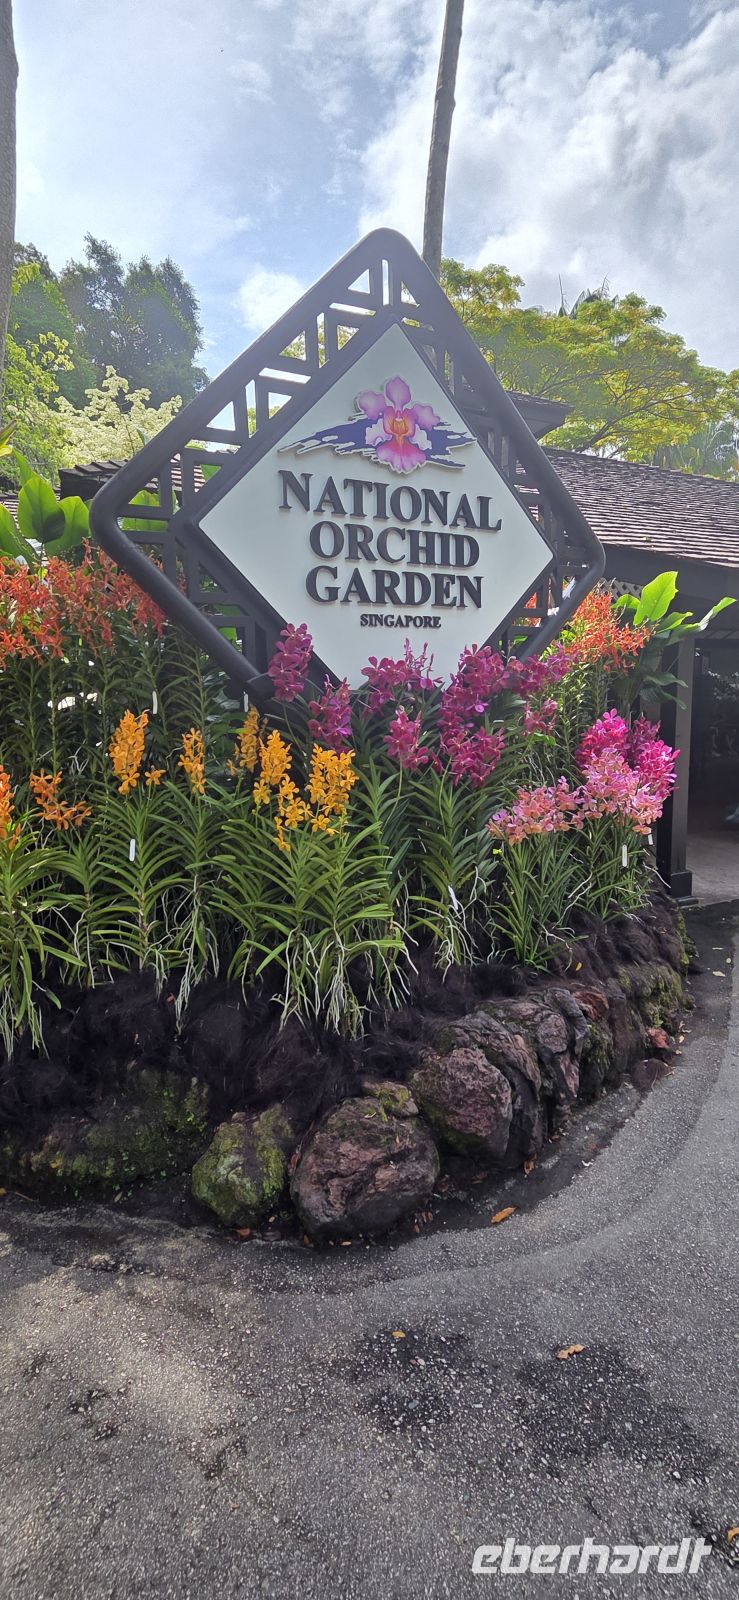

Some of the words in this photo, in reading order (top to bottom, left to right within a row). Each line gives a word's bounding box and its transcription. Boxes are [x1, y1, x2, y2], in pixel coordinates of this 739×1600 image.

[278, 470, 502, 531] NATIONAL
[309, 521, 480, 567] ORCHID
[305, 566, 484, 608] GARDEN
[360, 614, 441, 628] SINGAPORE
